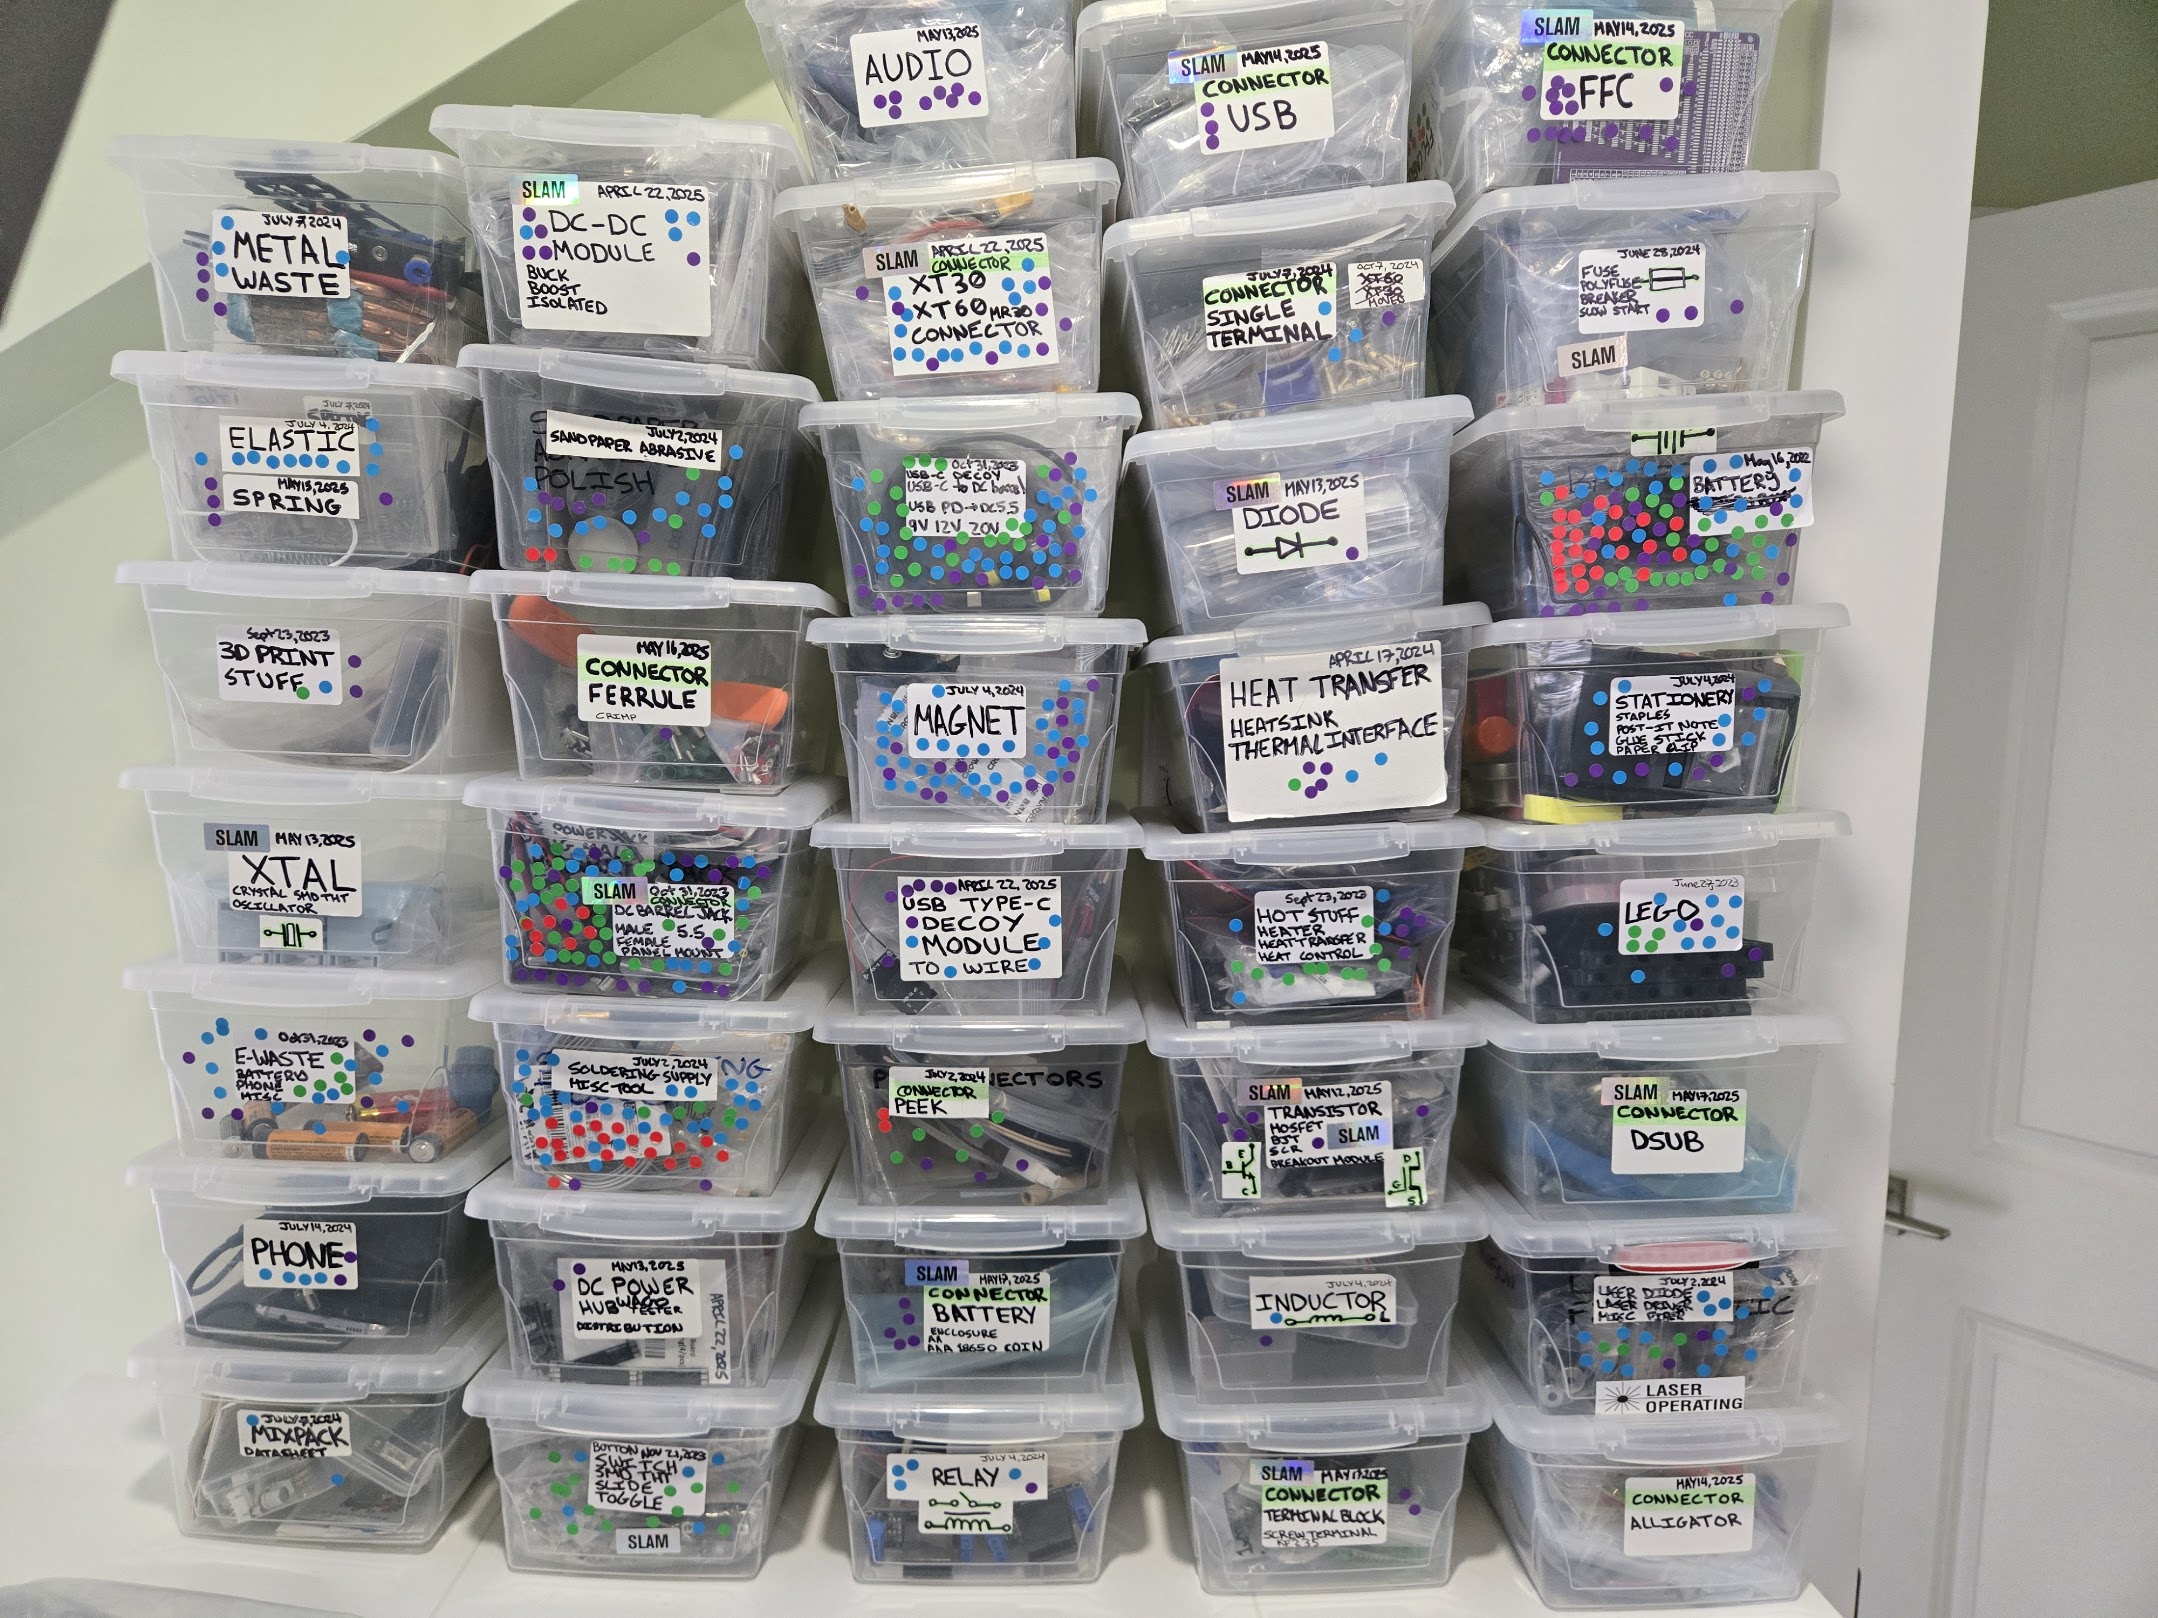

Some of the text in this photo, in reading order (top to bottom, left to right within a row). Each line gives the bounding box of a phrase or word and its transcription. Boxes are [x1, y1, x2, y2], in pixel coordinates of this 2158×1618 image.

[1534, 17, 1580, 36] SLAM
[1547, 42, 1674, 67] CONNECTOR
[865, 48, 972, 85] AUDIO
[1181, 54, 1225, 77] SLAM
[1201, 69, 1328, 98] CONNECTOR
[1580, 72, 1635, 109] FFC
[1226, 99, 1297, 132] USB
[522, 181, 566, 200] SLAM
[597, 184, 643, 200] APRIL
[549, 210, 647, 237] DC-DC
[234, 232, 346, 270] METAL
[552, 242, 656, 265] MODULE
[932, 242, 974, 257] APRIL
[876, 249, 919, 271] SLAM
[931, 255, 1011, 273] CONNECTOR
[527, 264, 570, 282] BUCK
[1582, 264, 1620, 279] FUSE
[232, 266, 340, 296] WASTE
[529, 279, 581, 297] BOOST
[910, 272, 986, 296] XT30
[1203, 274, 1328, 305] CONNECTOR
[1580, 277, 1642, 291] POLYFUSE
[527, 296, 608, 316] ISOLATED
[1580, 290, 1637, 305] BREAKER
[912, 300, 988, 321] XT60
[1206, 299, 1296, 326] SINGLE
[1579, 302, 1650, 318] SLOW START
[912, 320, 1042, 344] CONNECTOR
[1206, 321, 1332, 348] TERMINAL
[1571, 345, 1616, 369] SLAM
[230, 427, 355, 452] ELASTIC
[640, 441, 716, 462] ABRASIVE
[535, 465, 655, 495] POLISH
[973, 480, 988, 492] DC
[1694, 471, 1780, 495] BATTERY
[1226, 481, 1270, 503] SLAM
[233, 489, 341, 514] SPRING
[909, 501, 936, 513] USB
[1243, 498, 1340, 530] DIODE
[909, 518, 1000, 536] 9V 12V 20V
[219, 641, 334, 667] 3D PRINT
[1328, 650, 1372, 668] APRIL
[224, 669, 303, 691] STUFF
[586, 657, 709, 687] CONNECTOR
[1231, 664, 1432, 708] HEAT TRANSFER
[590, 683, 698, 710] FERRULE
[1615, 689, 1734, 709] STATIONERY
[596, 712, 637, 721] CRIMP
[914, 703, 1026, 739] MAGNET
[1230, 709, 1339, 740] HEATSINK
[1616, 709, 1671, 722] STAPLES
[1679, 719, 1718, 731] NOTE
[1227, 712, 1438, 762] THERMAL INTERFACE
[1616, 731, 1706, 746] GLUE STICK
[1616, 743, 1658, 755] PAPER
[215, 830, 258, 847] SLAM
[241, 855, 357, 892] XTAL
[232, 885, 350, 904] CRYSTAL SMD THT
[593, 883, 637, 900] SLAM
[232, 899, 318, 915] OSCILLATOR
[648, 896, 731, 908] CONNECTOR
[902, 896, 1051, 913] USB TYPE-C
[632, 906, 695, 918] BARREL
[1257, 906, 1360, 924] HOT STUFF
[1625, 900, 1700, 925] LEGO
[615, 922, 706, 939] MALE 5.5
[922, 913, 1025, 933] DECOY
[1257, 923, 1323, 938] HEATER
[616, 936, 672, 949] FEMALE
[922, 933, 1041, 956] MODULE
[621, 946, 723, 959] PANEL MOUNT
[1257, 949, 1363, 962] HEAT CONTROL
[909, 958, 1028, 975] TO WIRE
[235, 1046, 325, 1069] E-WASTE
[568, 1062, 713, 1085] SOLDERING SUPPLY
[236, 1080, 284, 1093] PHONE
[570, 1078, 655, 1095] MISC TOOL
[897, 1084, 977, 1100] CONNECTOR
[1248, 1084, 1290, 1101] SLAM
[1613, 1084, 1656, 1100] SLAM
[240, 1092, 282, 1102] MISC
[894, 1098, 948, 1115] PEEK
[1267, 1101, 1383, 1118] TRANSISTOR
[1616, 1105, 1738, 1122] CONNECTOR
[1269, 1120, 1324, 1134] MOSFET
[1338, 1125, 1379, 1144] SLAM
[1270, 1134, 1299, 1146] BJT
[1630, 1129, 1704, 1152] DSUB
[1270, 1145, 1303, 1157] SCR
[1269, 1152, 1384, 1169] BREAKOUT MODULE
[251, 1237, 345, 1269] PHONE
[916, 1265, 958, 1281] SLAM
[578, 1277, 694, 1297] DC POWER
[928, 1287, 1048, 1302] CONNECTOR
[1642, 1286, 1694, 1300] DIODE
[581, 1301, 618, 1316] HUB
[1255, 1290, 1386, 1312] INDUCTOR
[932, 1303, 1036, 1324] BATTERY
[577, 1321, 684, 1333] DISTRIBUTION
[930, 1327, 998, 1339] ENCLOSURE
[927, 1341, 1043, 1353] AAA 18650 COIN
[928, 1335, 943, 1344] AA
[1646, 1383, 1702, 1397] LASER
[1646, 1397, 1743, 1413] OPERATING
[251, 1424, 349, 1447] MIXPACK
[244, 1446, 328, 1458] DATASHEET
[933, 1466, 1000, 1487] RELAY
[1261, 1466, 1303, 1481] SLAM
[595, 1480, 654, 1494] SLIDE
[1265, 1484, 1381, 1502] CONNECTOR
[596, 1492, 664, 1511] TOGGLE
[1632, 1491, 1744, 1506] CONNECTOR
[1263, 1508, 1386, 1525] TERMINAL BLOCK
[1630, 1513, 1743, 1531] ALLIGATOR
[628, 1534, 669, 1549] SLAM
[1264, 1527, 1378, 1540] SCREW TERMINAL
